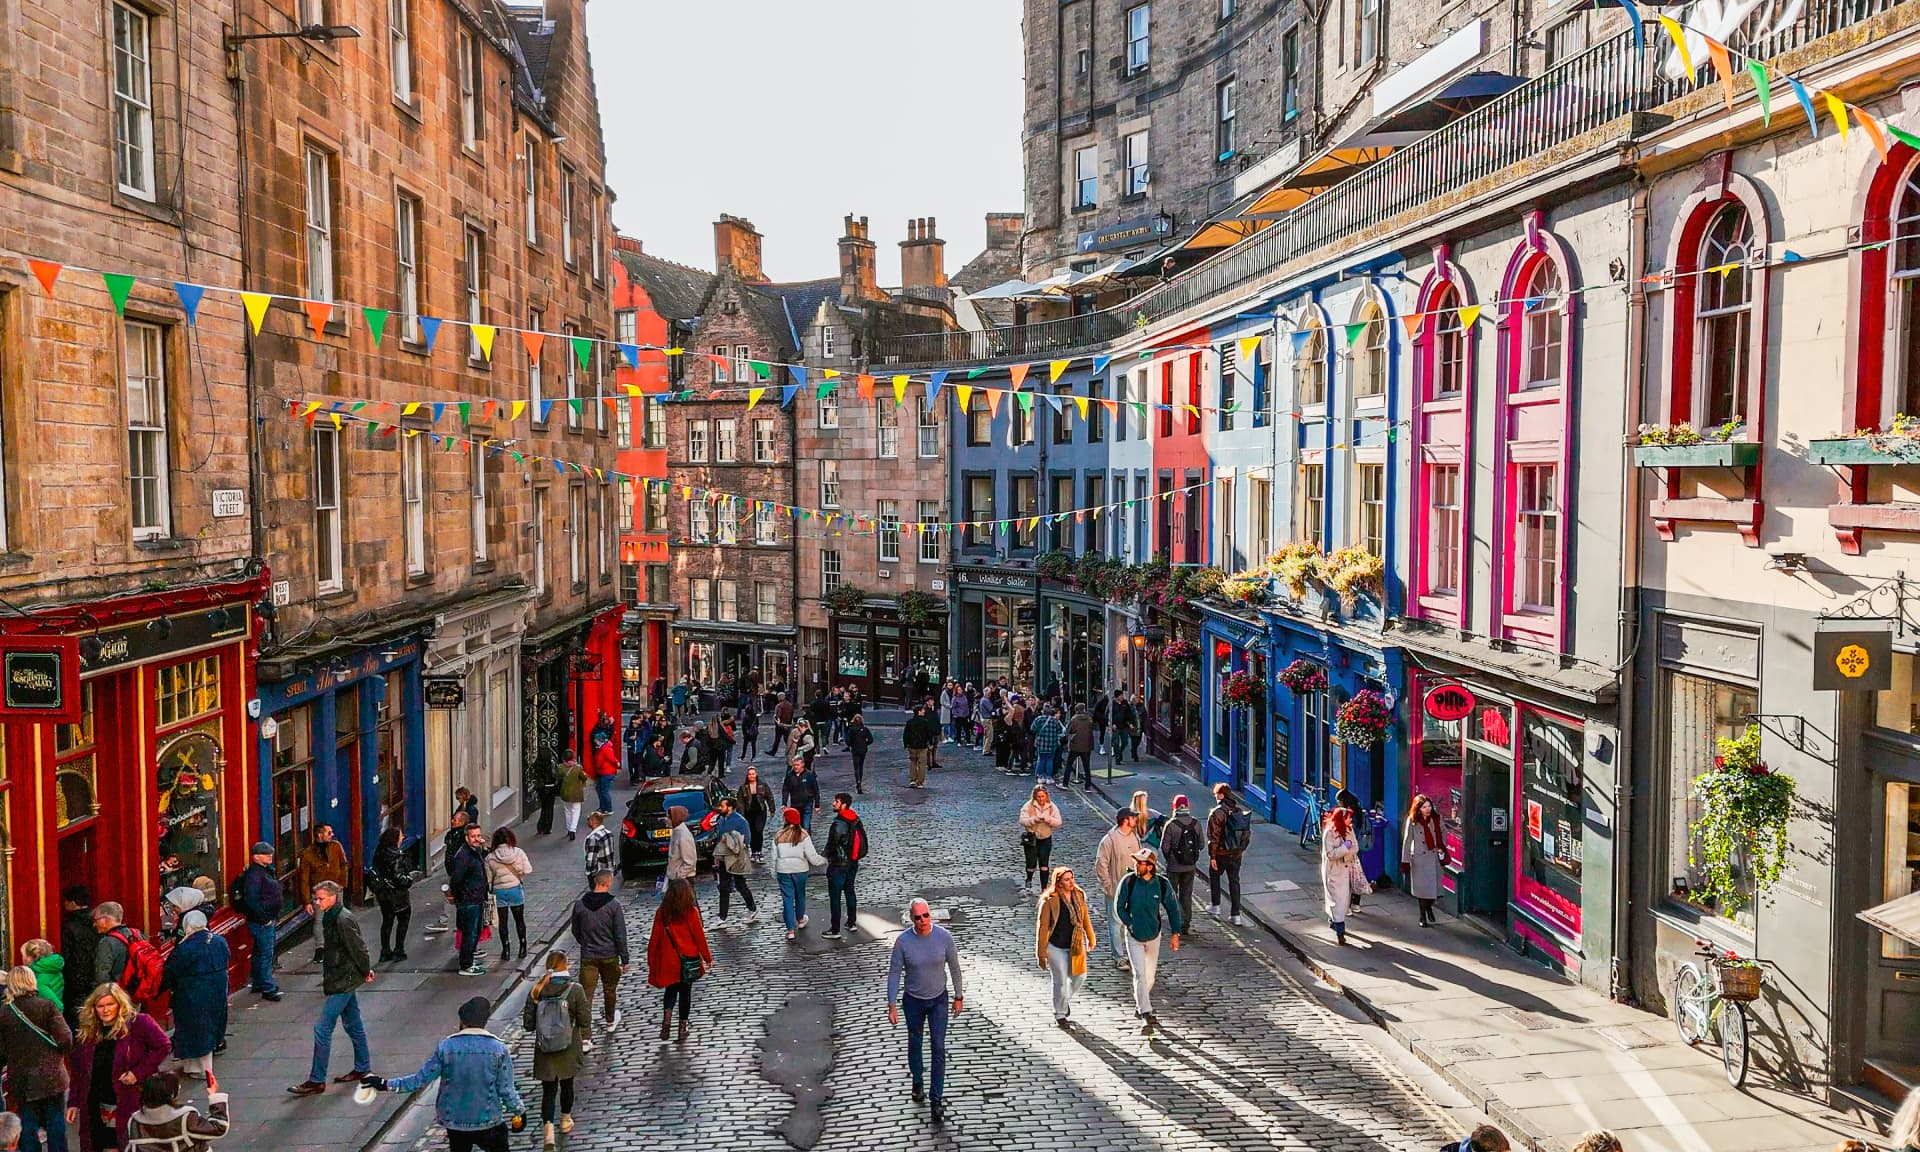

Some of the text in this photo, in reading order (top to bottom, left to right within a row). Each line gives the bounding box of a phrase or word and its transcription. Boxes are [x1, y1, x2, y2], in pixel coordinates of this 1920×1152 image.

[215, 491, 242, 502] VICTORIA
[219, 503, 239, 514] STREET
[1174, 512, 1184, 544] 40
[979, 573, 1003, 584] Walker
[1006, 575, 1028, 586] Slater
[275, 582, 288, 593] WEST
[462, 613, 491, 637] SAHARA
